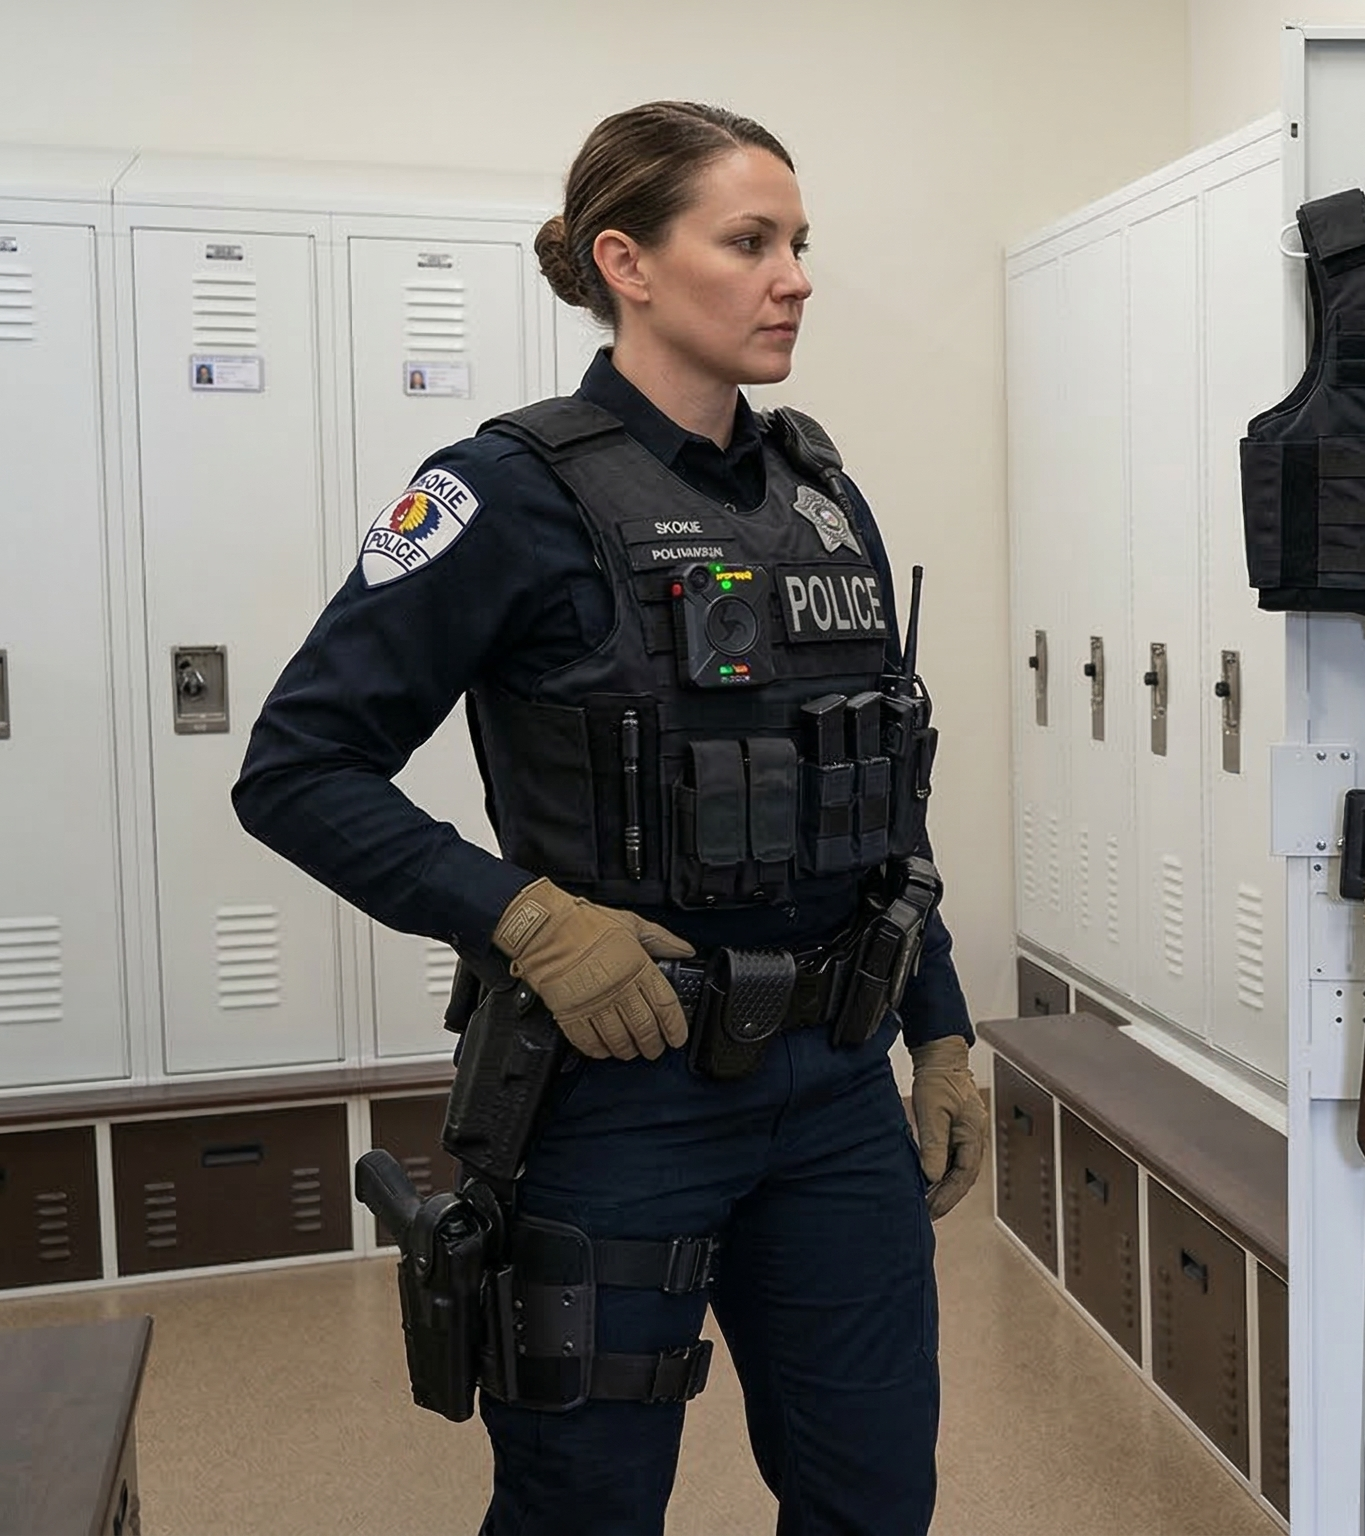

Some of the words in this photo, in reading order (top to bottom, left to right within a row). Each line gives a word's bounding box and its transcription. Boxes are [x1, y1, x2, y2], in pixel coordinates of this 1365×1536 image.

[654, 521, 703, 534] SKOKIE
[366, 532, 420, 567] POLICE
[785, 576, 886, 632] POLICE
